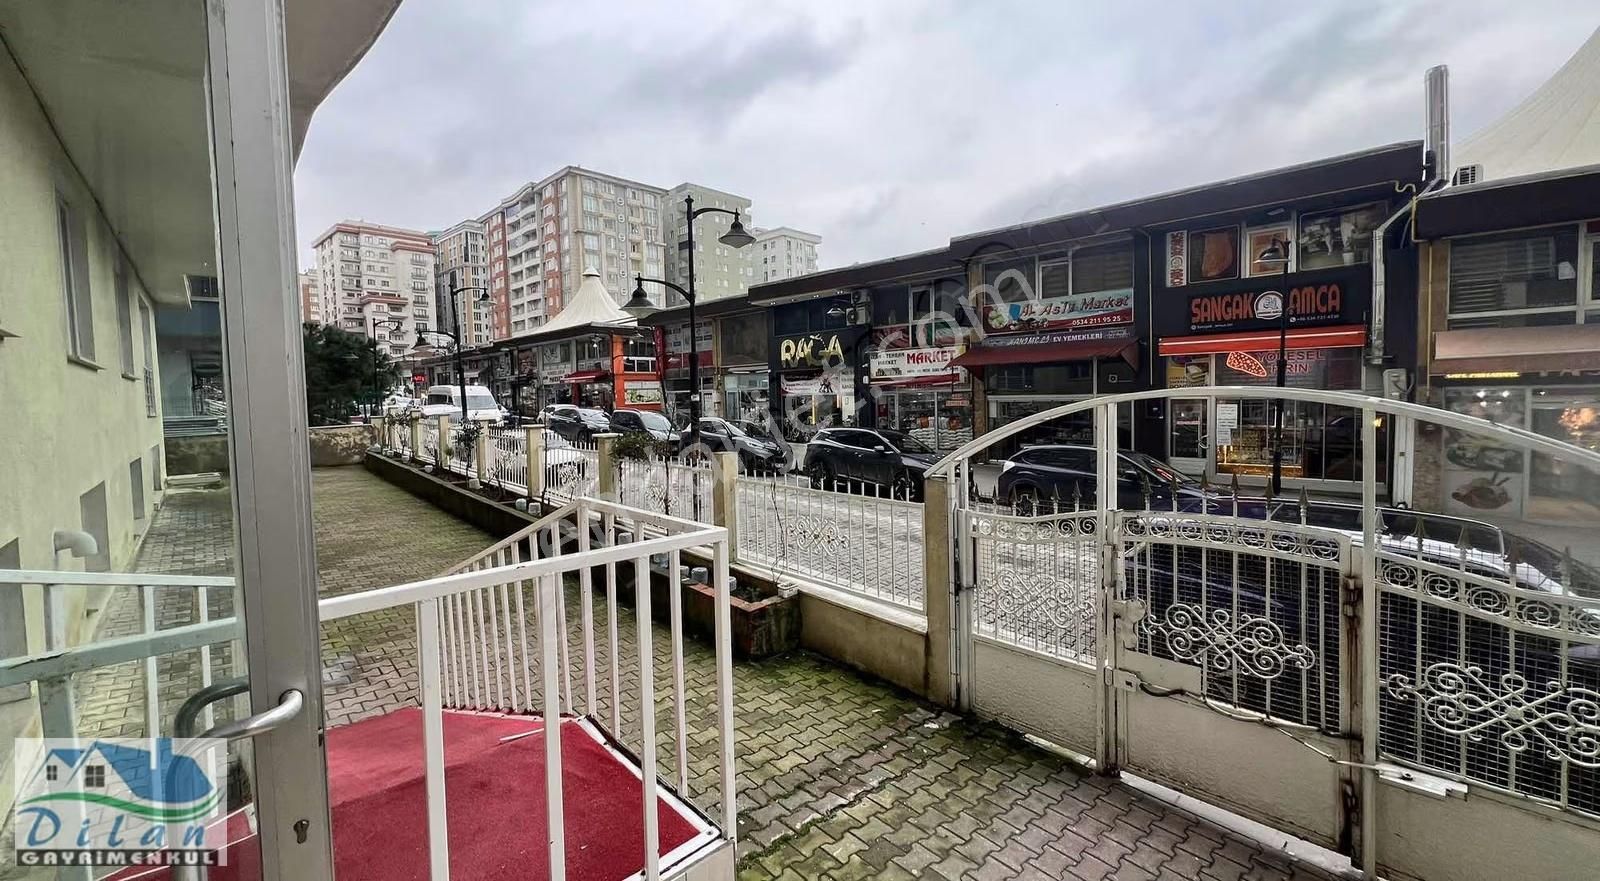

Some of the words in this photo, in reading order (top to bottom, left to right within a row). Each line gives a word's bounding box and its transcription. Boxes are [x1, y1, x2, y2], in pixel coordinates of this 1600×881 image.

[1080, 295, 1129, 311] Market
[1191, 292, 1254, 323] SANGAK
[1289, 284, 1341, 316] AMCA
[906, 350, 956, 365] MARKET
[1269, 362, 1308, 374] FRIN
